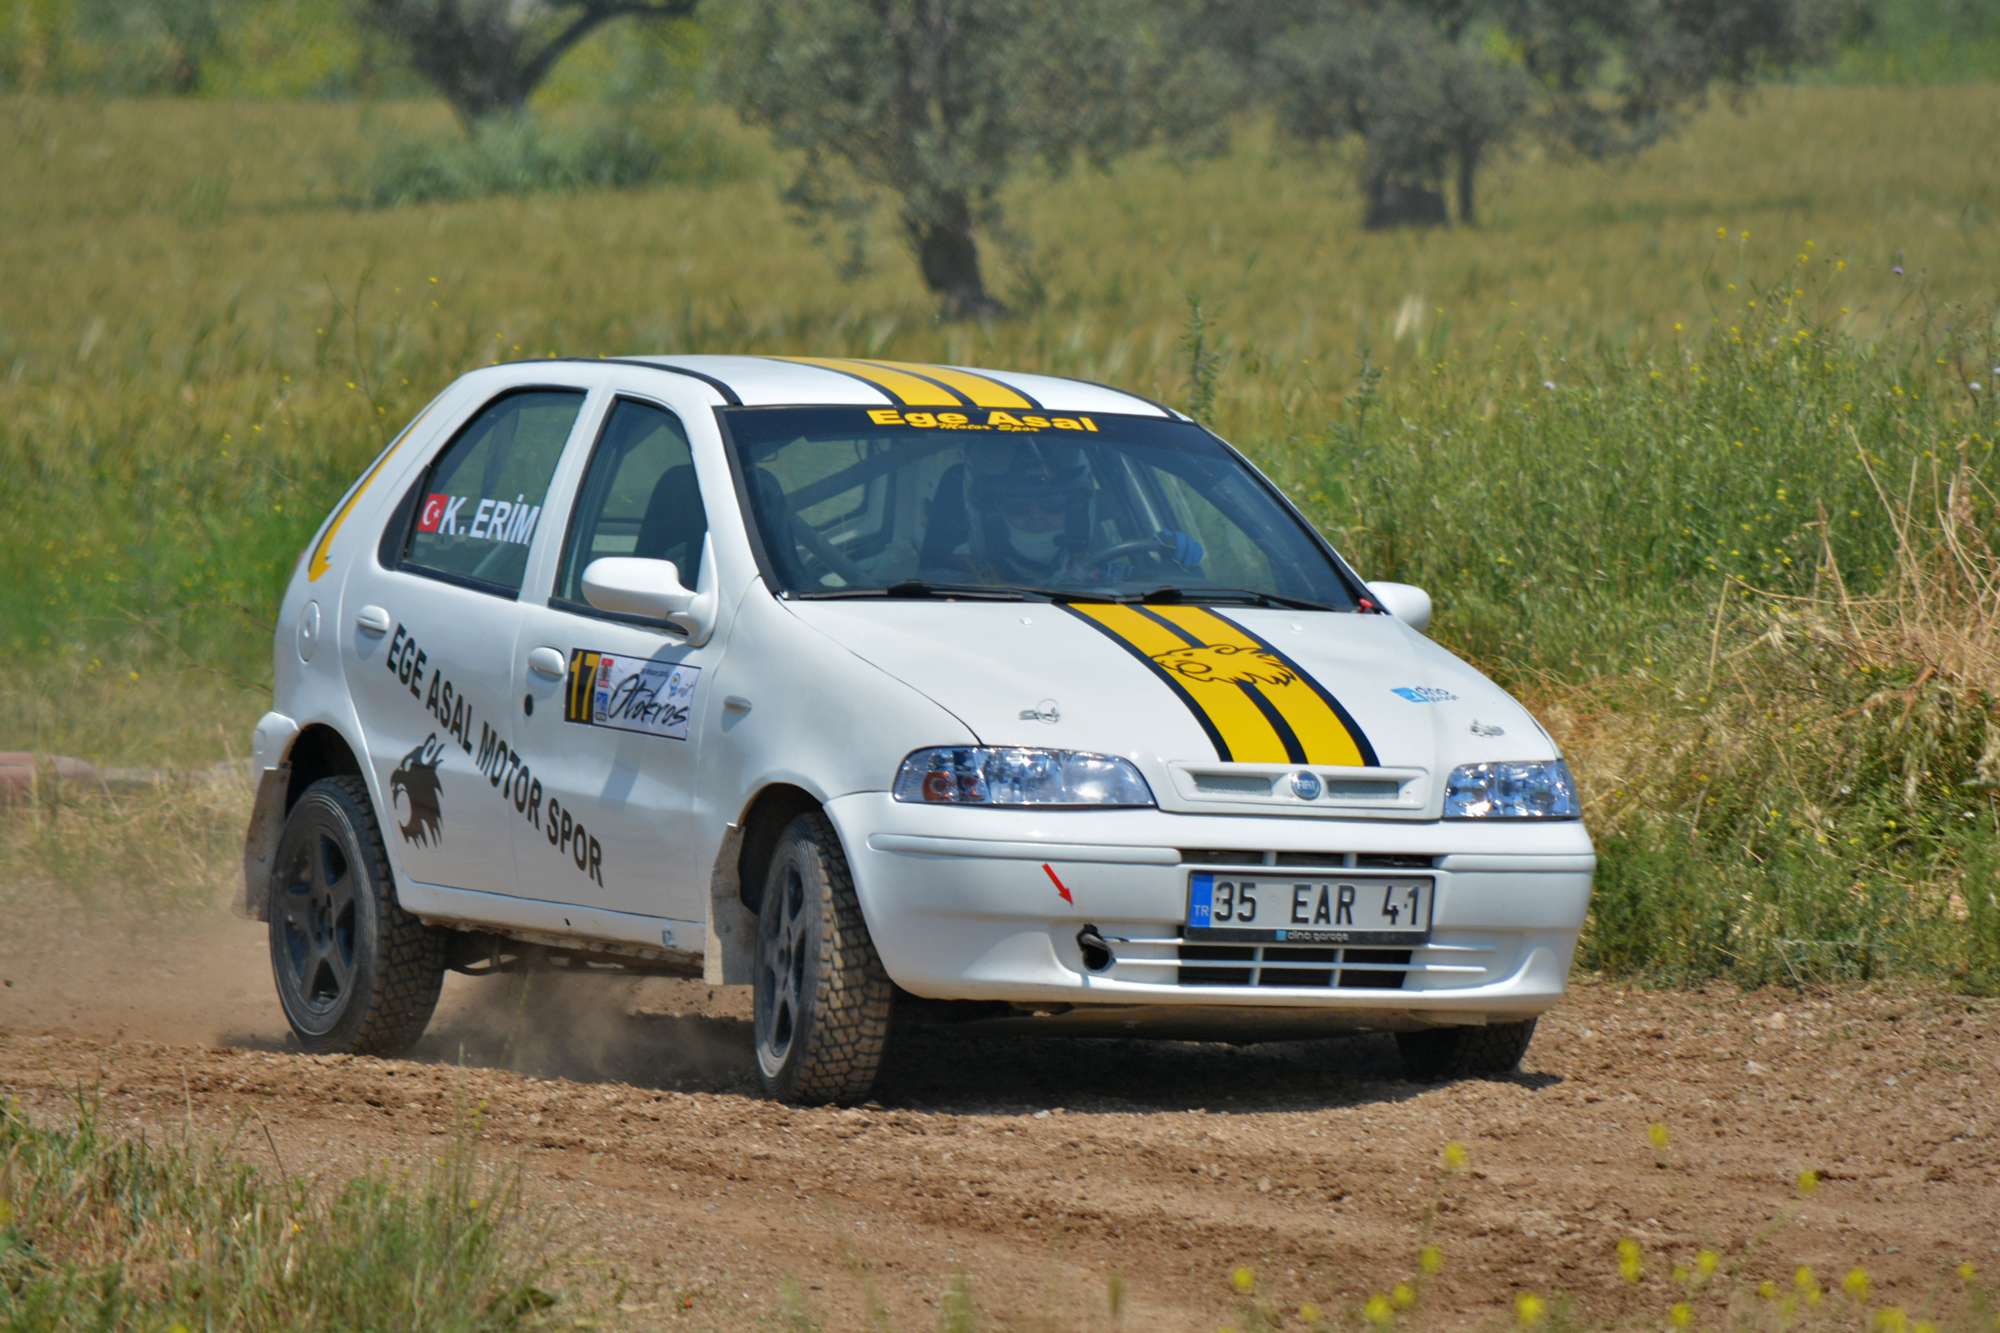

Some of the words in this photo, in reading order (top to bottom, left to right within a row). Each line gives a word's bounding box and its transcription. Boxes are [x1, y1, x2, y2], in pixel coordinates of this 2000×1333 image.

[866, 409, 969, 428] Ege
[987, 410, 1099, 432] Asal
[937, 422, 992, 431] Motor
[997, 424, 1041, 432] Spor
[437, 495, 466, 536] K.
[469, 493, 541, 545] ERİM
[570, 650, 601, 721] 17
[386, 622, 428, 701] EGE
[425, 668, 473, 756] ASAL
[475, 720, 543, 832] MOTOR
[546, 797, 604, 889] SPOR
[1297, 779, 1317, 791] FIAT
[1193, 904, 1210, 917] TR
[1213, 881, 1257, 923] 35
[1290, 883, 1357, 926] EAR
[1381, 885, 1420, 926] 41
[1287, 930, 1311, 940] dino
[1313, 932, 1350, 942] garage
